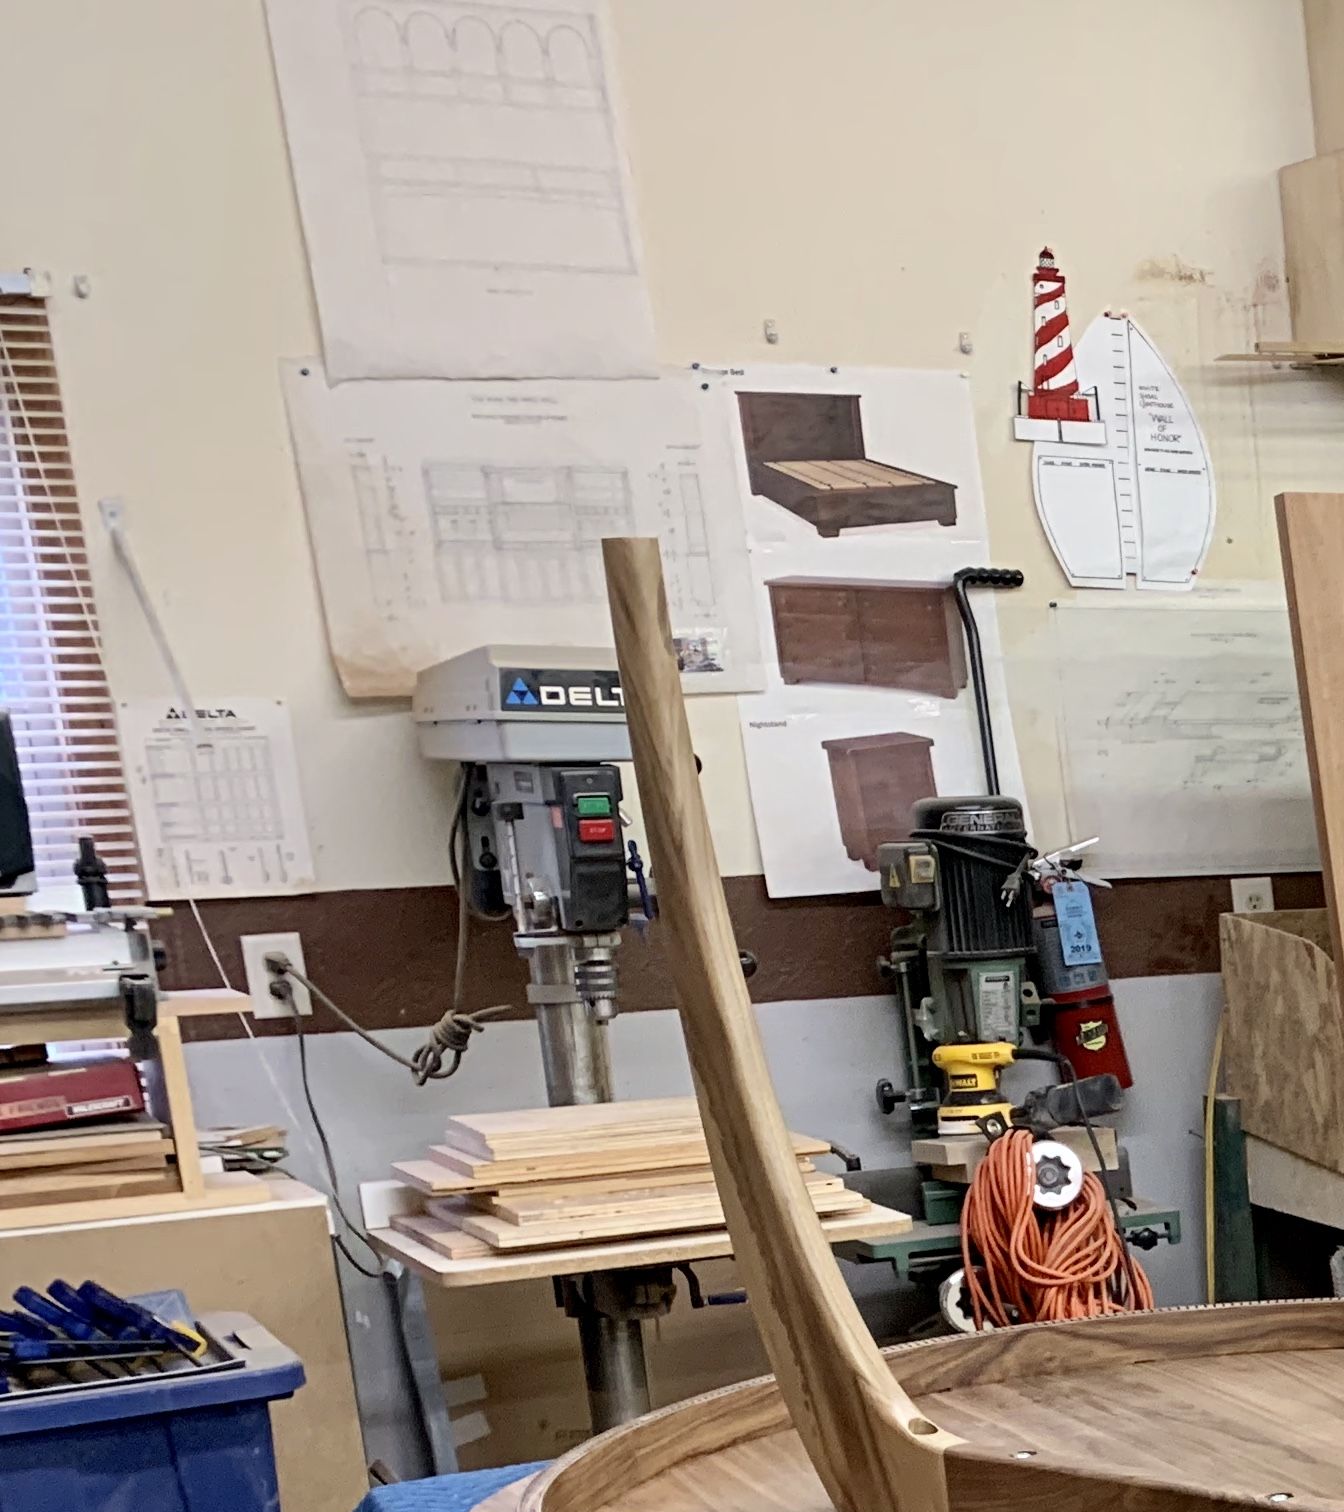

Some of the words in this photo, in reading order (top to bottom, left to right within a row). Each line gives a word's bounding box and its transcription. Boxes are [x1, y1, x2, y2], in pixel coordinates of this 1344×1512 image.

[1157, 424, 1167, 432] OF
[539, 685, 625, 707] DELT
[1070, 944, 1092, 953] 2019
